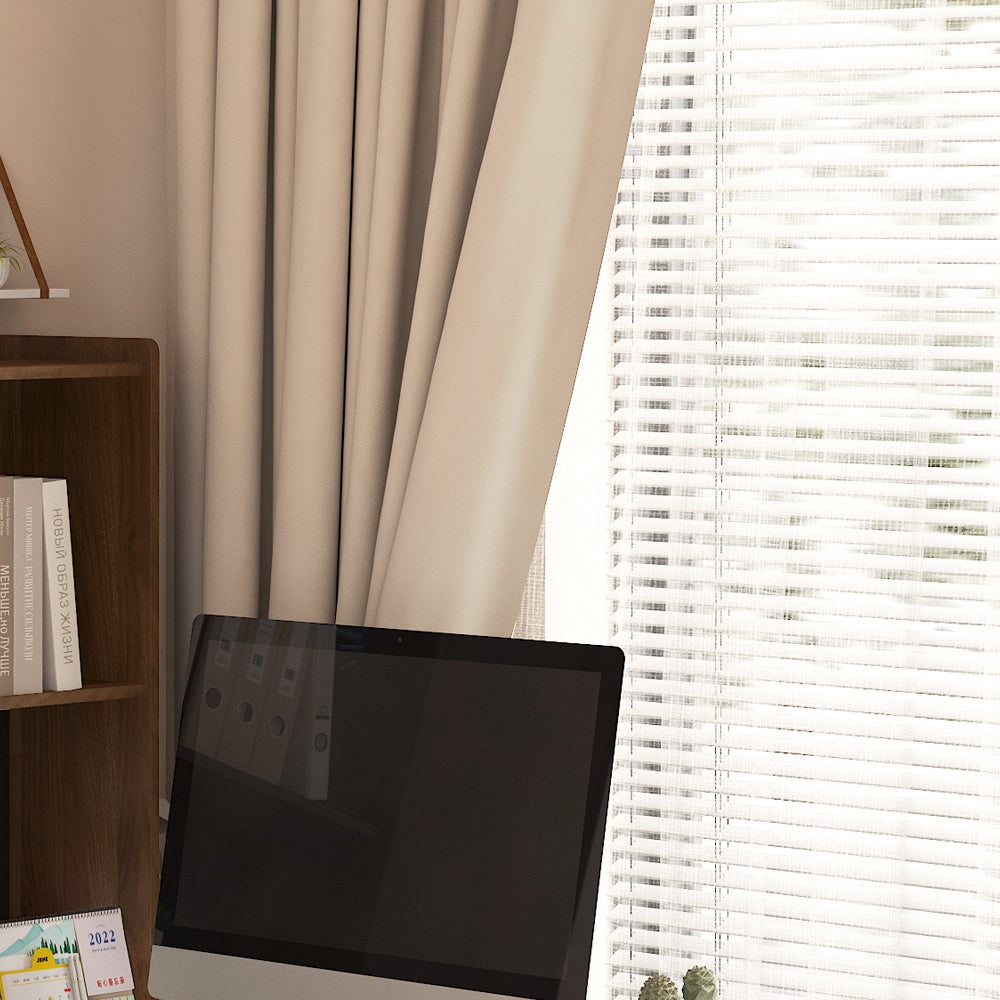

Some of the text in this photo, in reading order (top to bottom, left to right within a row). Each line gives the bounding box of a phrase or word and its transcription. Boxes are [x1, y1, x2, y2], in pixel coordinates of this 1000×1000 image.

[53, 508, 74, 665] НОВЫЙ ОБРАЗ ЖИЗНИ
[0, 636, 10, 677] ЛУЧШЕ
[89, 929, 116, 945] 2022
